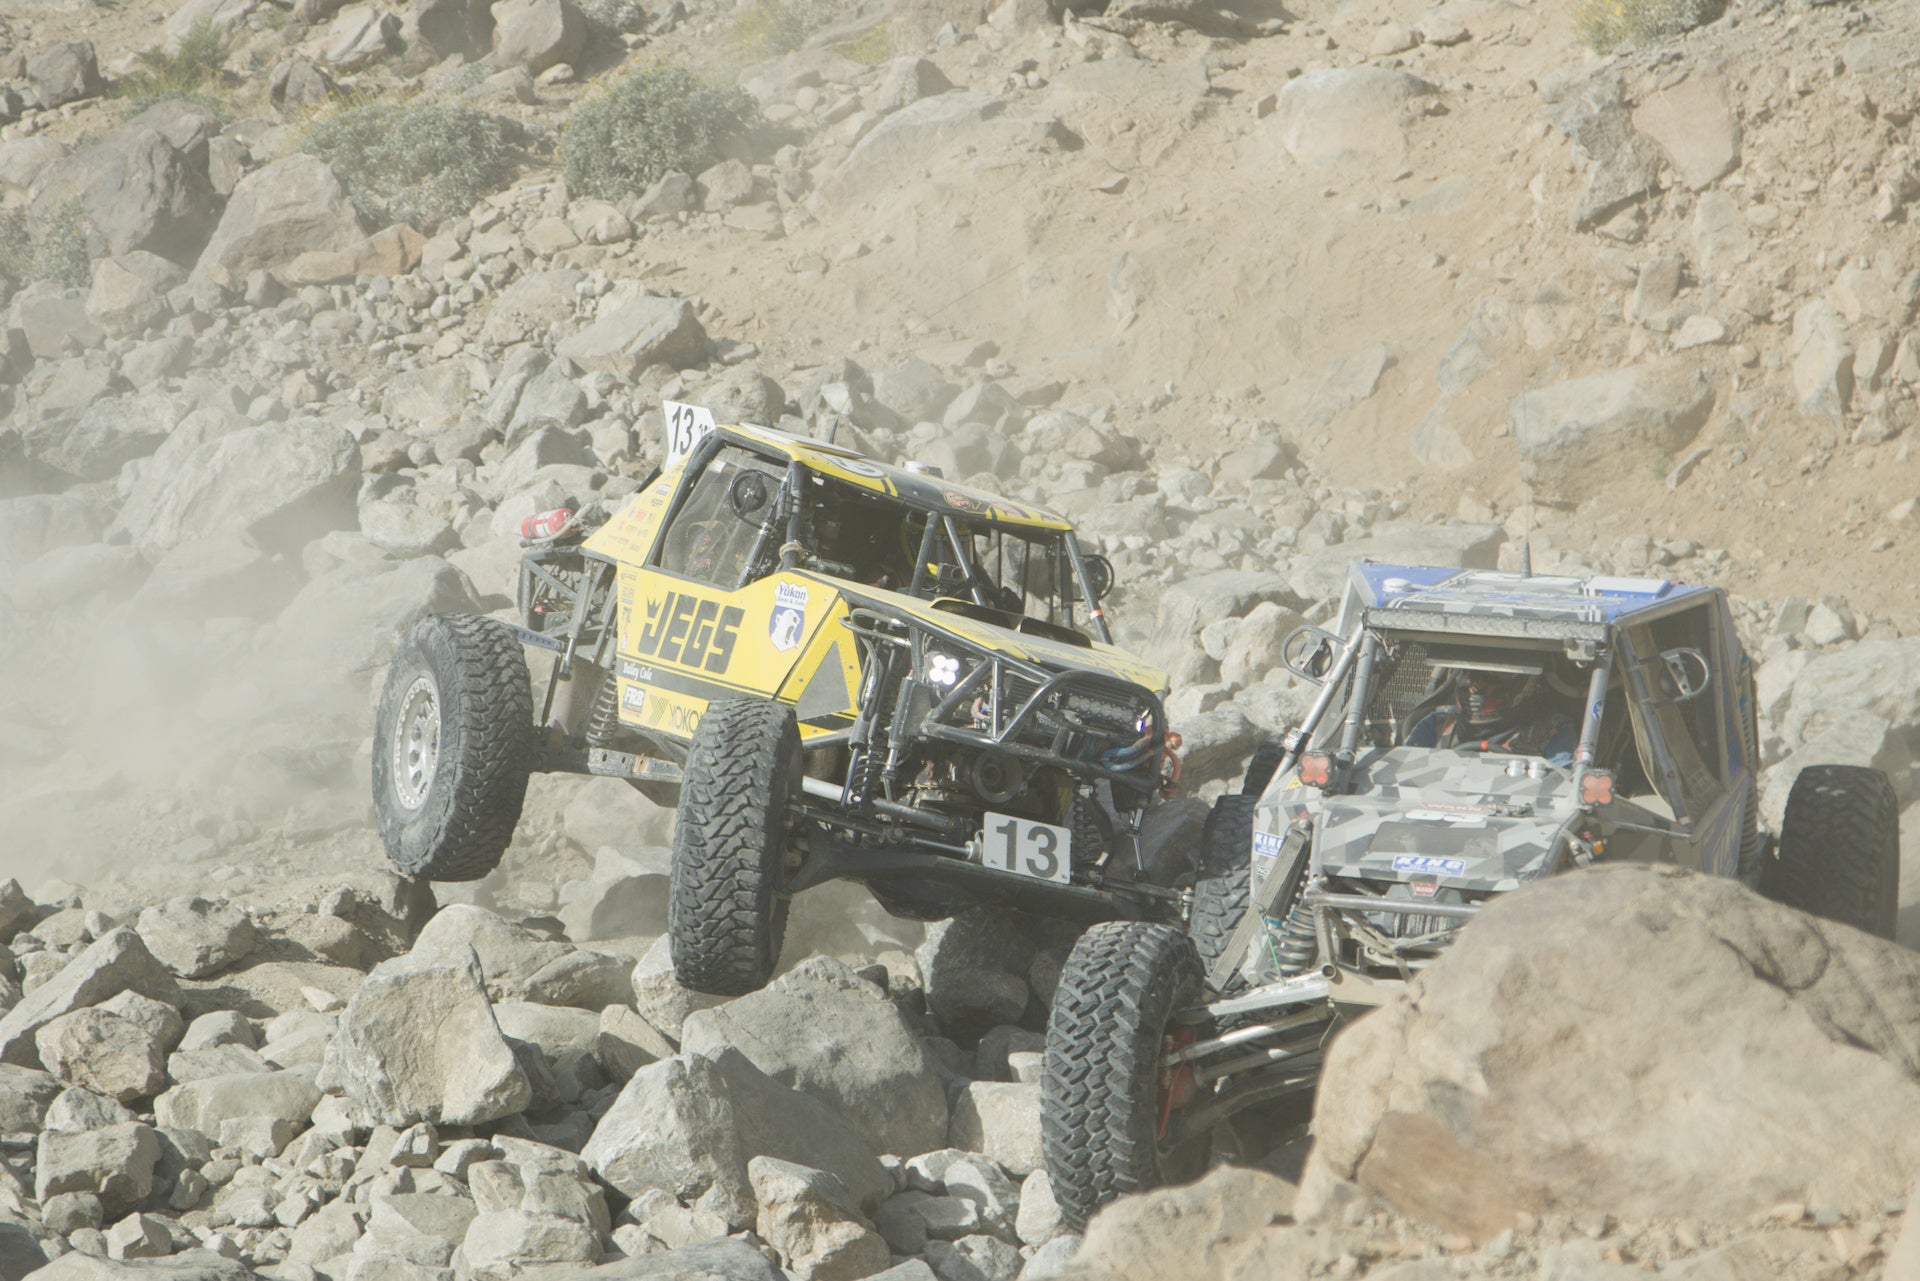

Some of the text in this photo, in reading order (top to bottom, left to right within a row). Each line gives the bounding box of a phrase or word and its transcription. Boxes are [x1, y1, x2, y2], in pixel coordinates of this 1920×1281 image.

[672, 405, 694, 456] 13
[638, 591, 746, 675] JEGS
[669, 703, 704, 734] YOKO
[996, 820, 1059, 878] 13
[1395, 856, 1463, 870] KING
